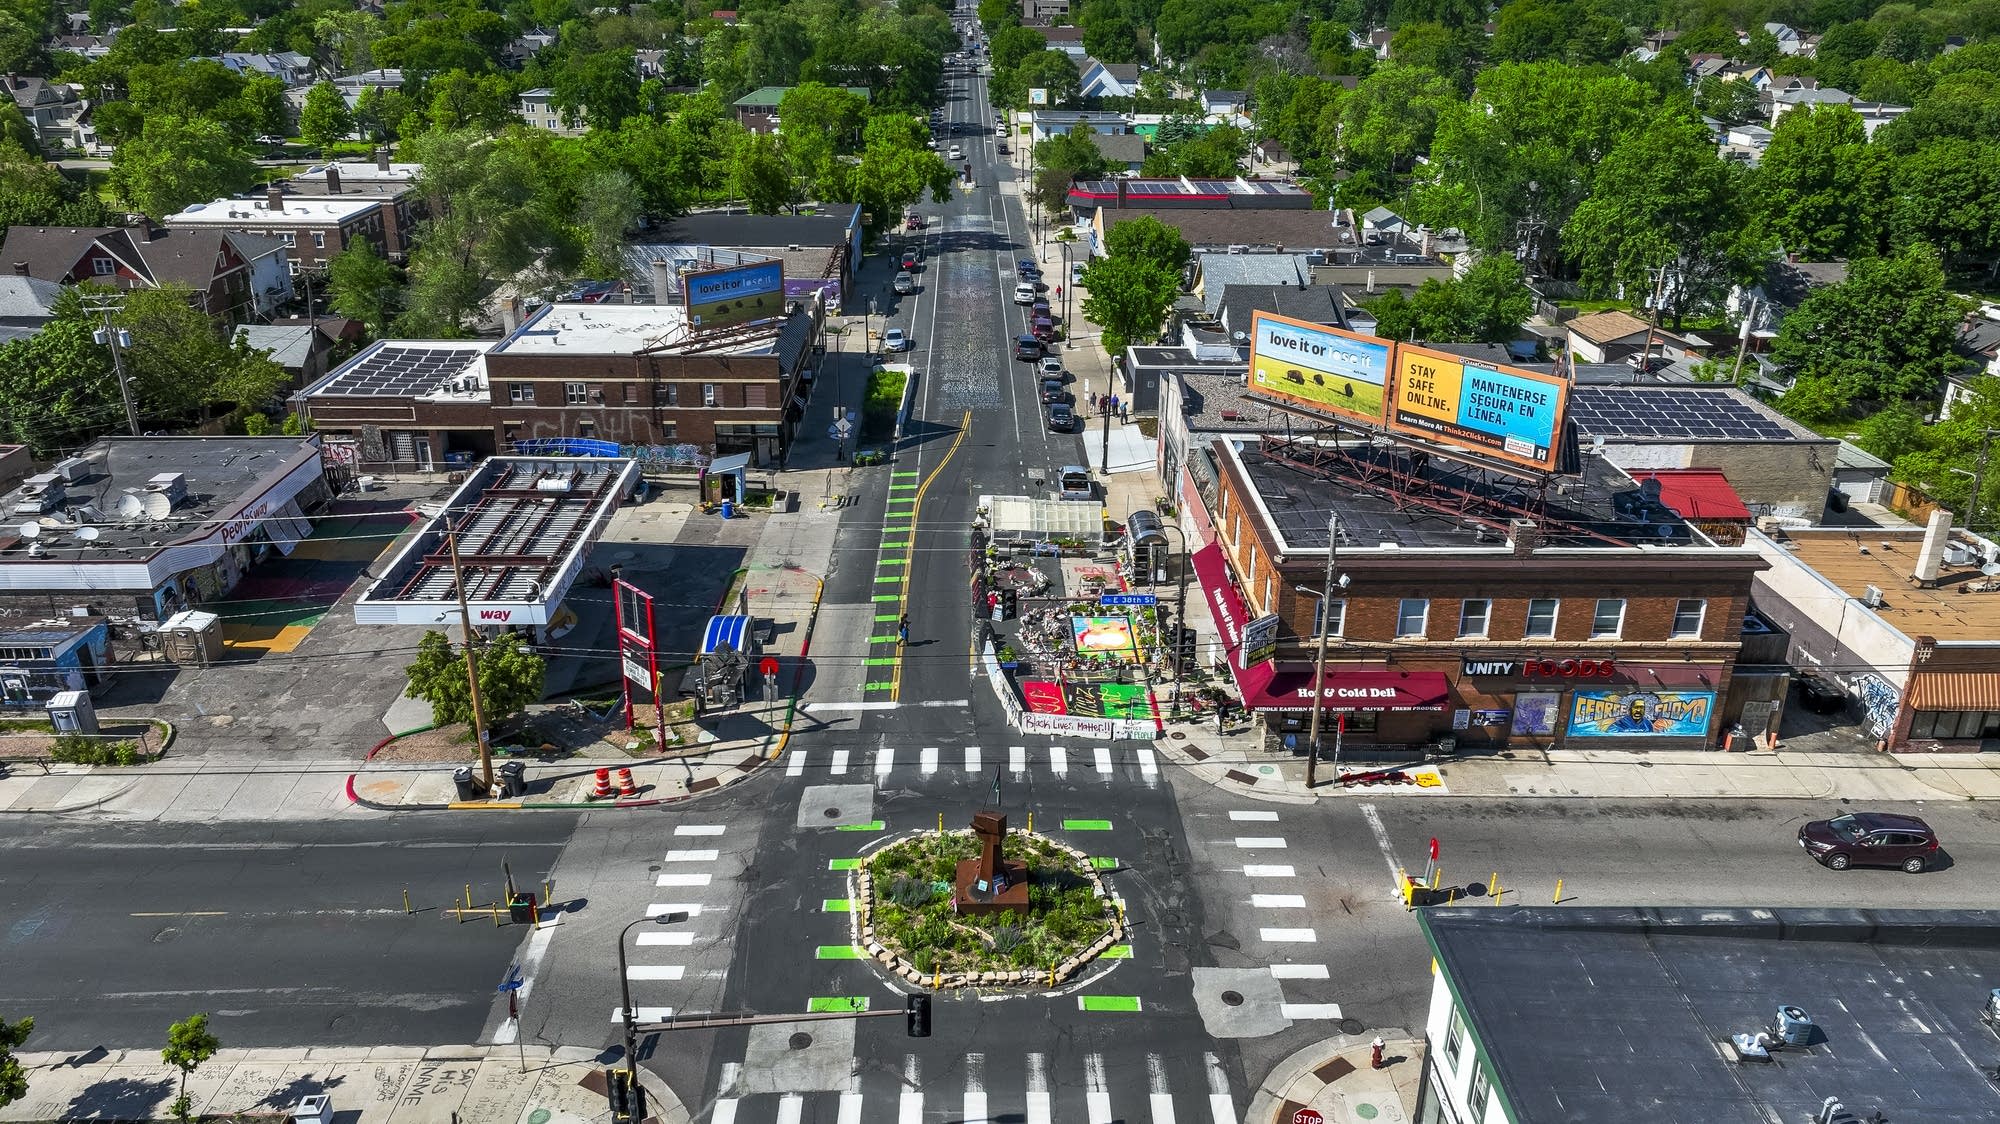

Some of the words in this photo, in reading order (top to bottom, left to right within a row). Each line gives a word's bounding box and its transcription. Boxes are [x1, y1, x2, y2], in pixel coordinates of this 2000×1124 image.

[700, 283, 720, 293] love
[722, 280, 730, 290] it
[731, 280, 740, 289] or
[1270, 331, 1297, 350] love
[1299, 338, 1309, 353] it
[1311, 344, 1327, 356] or
[1328, 345, 1358, 364] lose
[1361, 352, 1372, 369] it
[1410, 363, 1436, 379] STAY
[1408, 377, 1435, 394] SAFE
[1471, 377, 1547, 406] MANTENERSE
[1407, 391, 1451, 412] ONLINE.
[1470, 392, 1514, 413] SEGURA
[1519, 404, 1535, 418] EN
[1467, 402, 1507, 426] LÍNEA.
[1400, 413, 1418, 425] Learn
[1418, 418, 1434, 430] More
[1434, 422, 1443, 431] At
[1443, 425, 1502, 447] Think2Click1.com
[253, 501, 268, 519] way
[1121, 596, 1142, 604] 38th
[1144, 596, 1154, 604] St
[480, 610, 511, 622] way
[1465, 662, 1513, 675] UNITY
[1522, 658, 1616, 678] FOODS
[1297, 688, 1316, 698] Ho
[1323, 688, 1335, 698] &
[1337, 687, 1367, 698] Cold
[1370, 687, 1396, 698] Deli
[1024, 714, 1050, 732] Black
[402, 1067, 437, 1107] NAME
[453, 1068, 476, 1088] SAY
[1295, 1114, 1323, 1124] STOP
